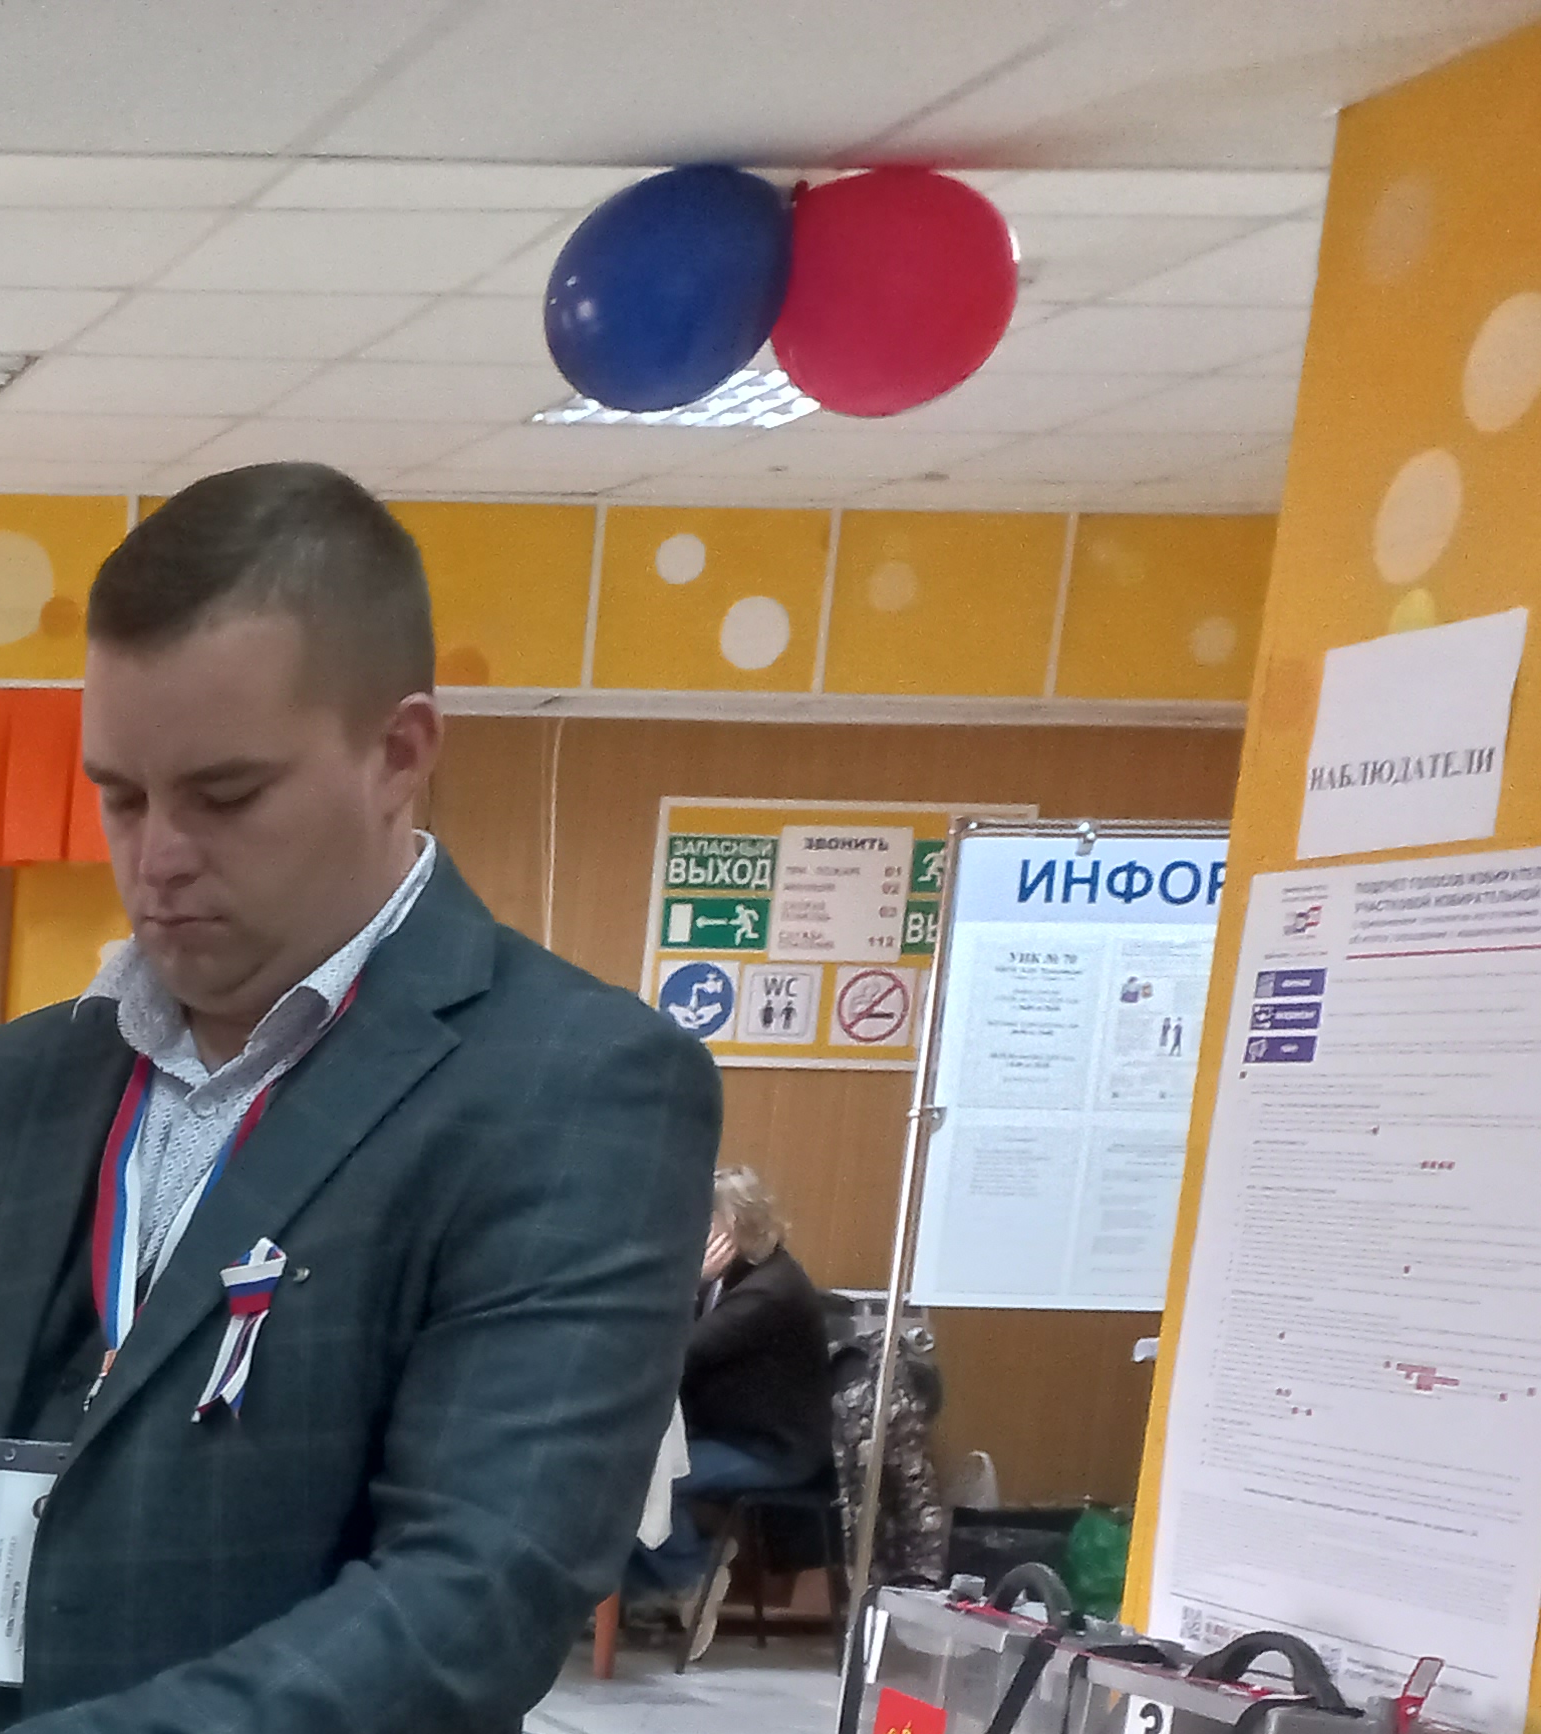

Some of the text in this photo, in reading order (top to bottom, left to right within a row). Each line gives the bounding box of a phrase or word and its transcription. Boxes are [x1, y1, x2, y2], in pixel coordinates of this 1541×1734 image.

[1309, 746, 1496, 791] НАБЛЮДАТЕЛИ
[803, 837, 890, 851] ЗВОНИТЬ
[668, 858, 772, 889] ВЫХОД
[764, 977, 798, 997] WC
